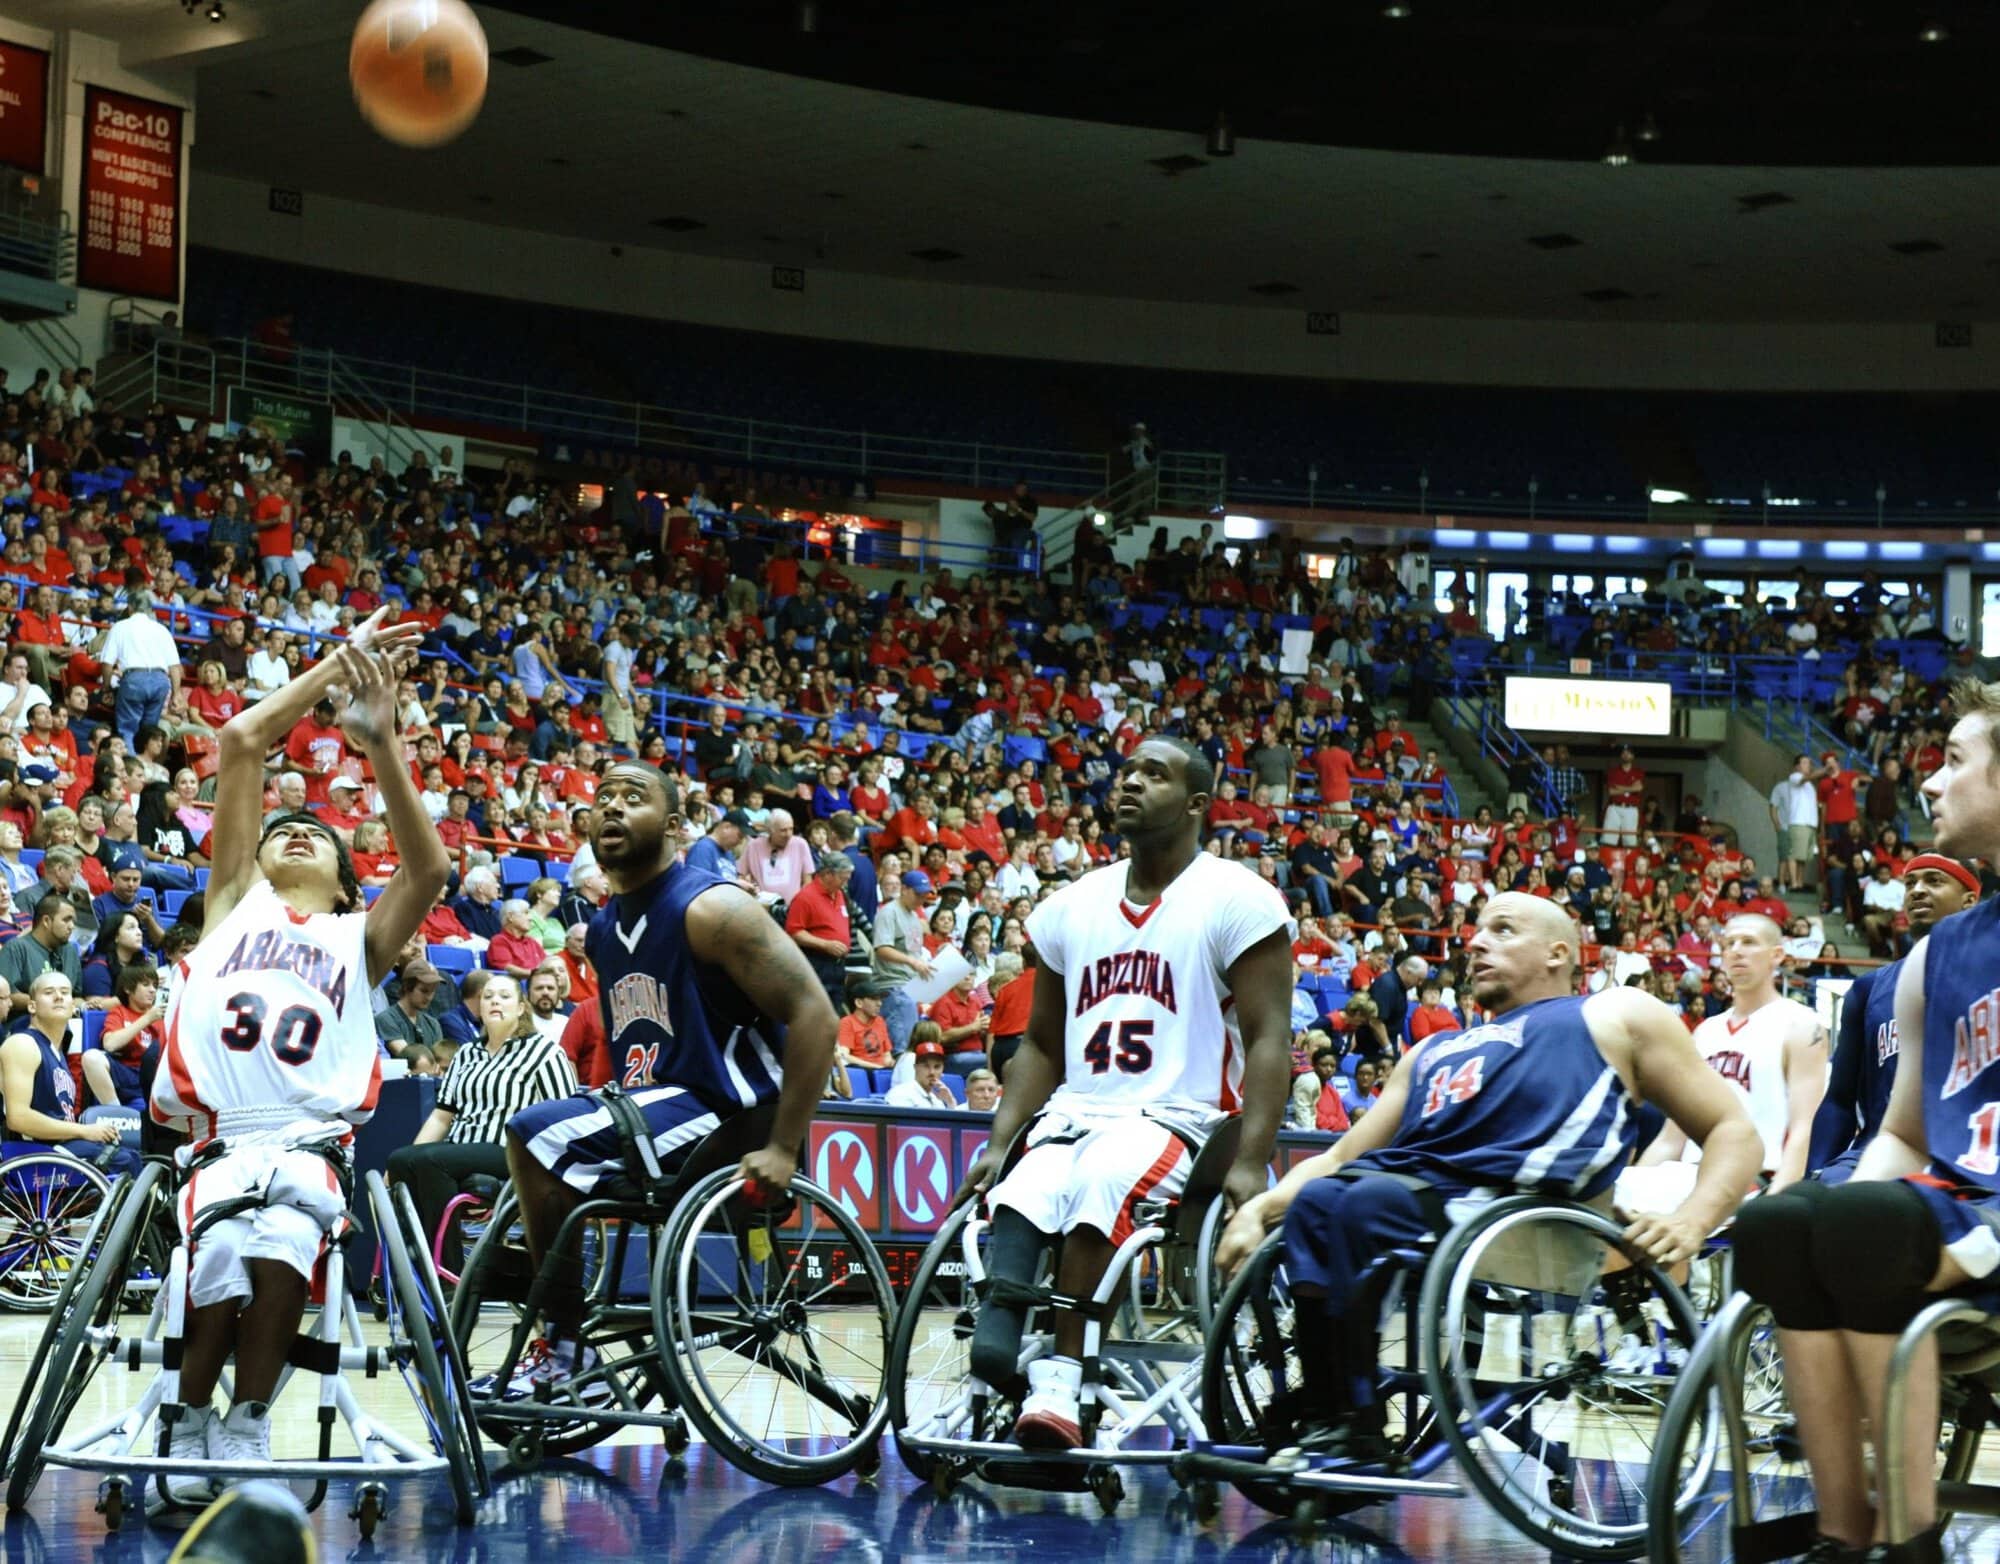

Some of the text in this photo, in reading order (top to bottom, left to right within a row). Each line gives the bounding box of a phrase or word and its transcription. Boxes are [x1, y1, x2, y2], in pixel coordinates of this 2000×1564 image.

[94, 123, 172, 154] CONFERENCE
[97, 101, 170, 138] Pac-10
[104, 166, 159, 190] CHAMPIONS
[119, 154, 174, 178] BASKETBALL
[252, 396, 311, 420] The future
[216, 929, 347, 1022] ARIZONA
[1075, 949, 1178, 1018] ARIZONA
[220, 991, 322, 1066] 30
[1084, 1019, 1155, 1075] 45
[623, 1042, 660, 1088] 21
[1420, 1055, 1486, 1119] 14
[807, 1267, 823, 1279] FLS
